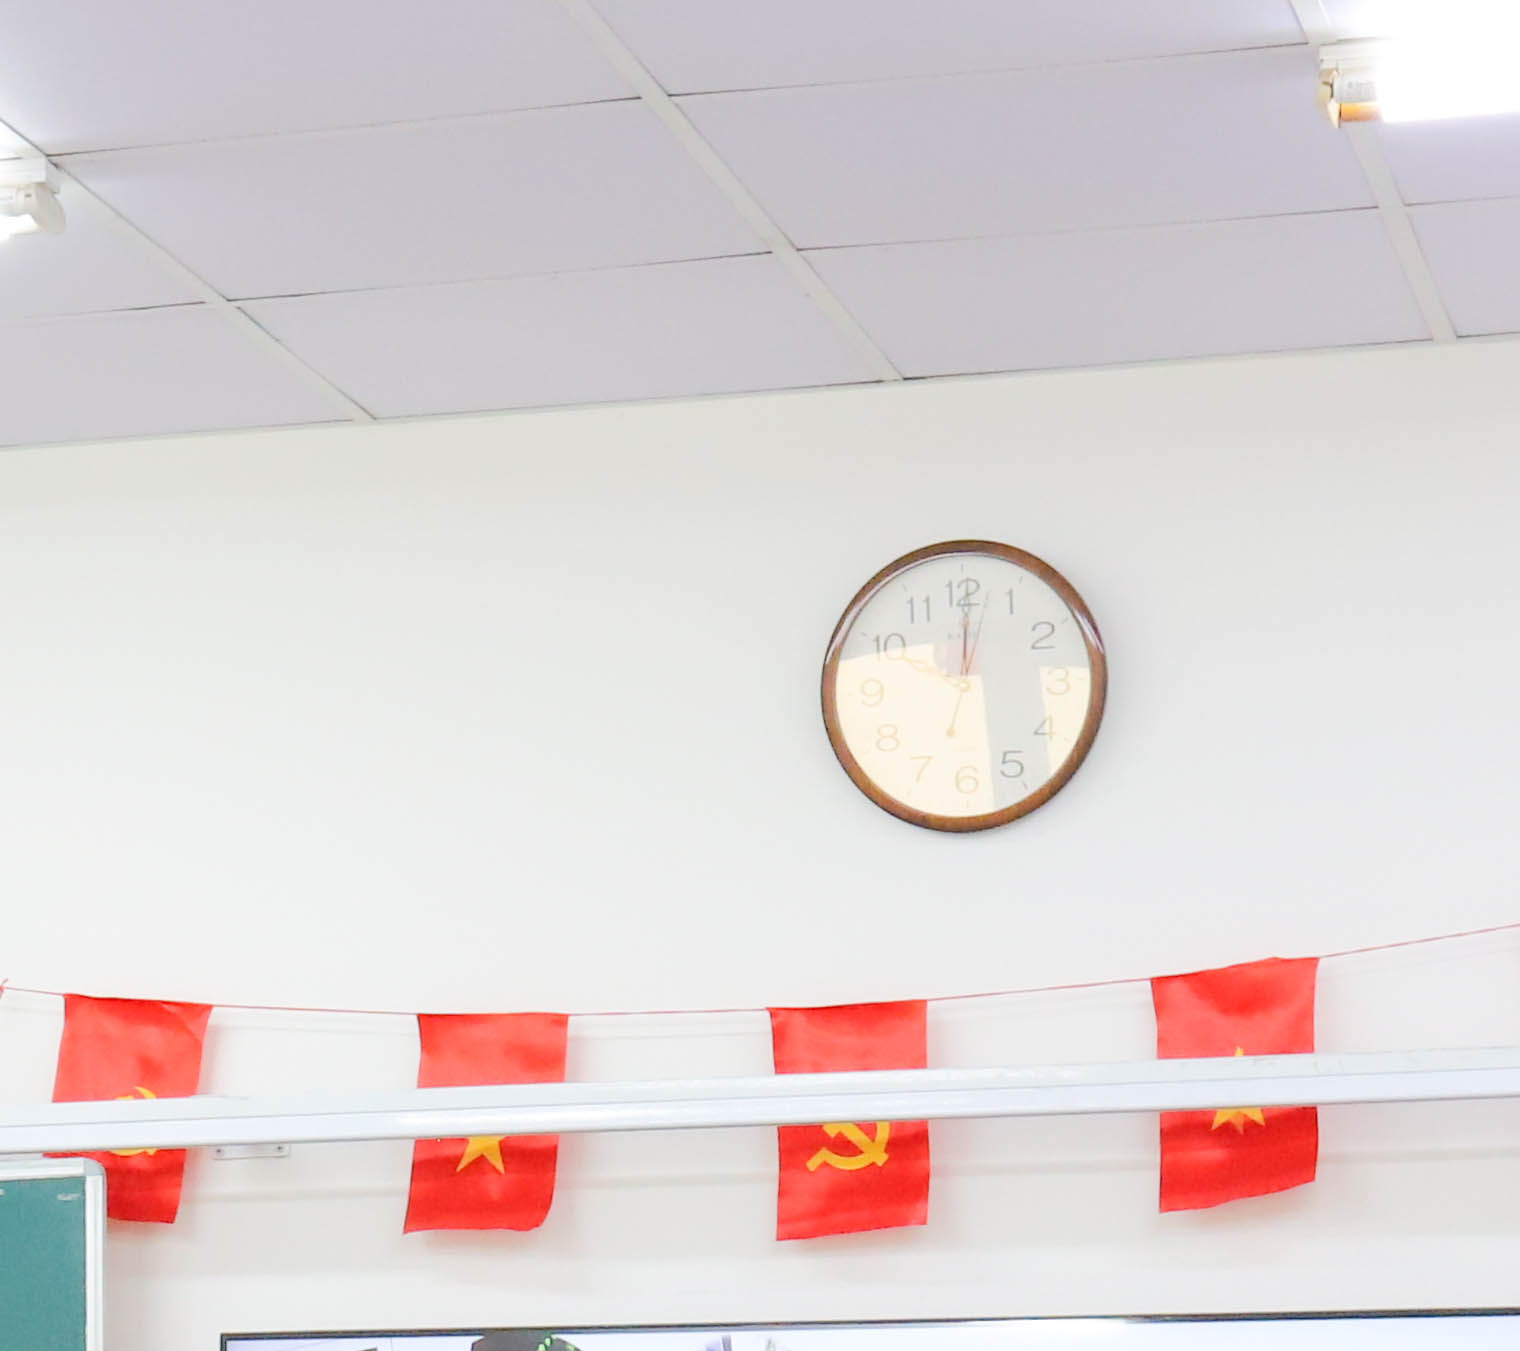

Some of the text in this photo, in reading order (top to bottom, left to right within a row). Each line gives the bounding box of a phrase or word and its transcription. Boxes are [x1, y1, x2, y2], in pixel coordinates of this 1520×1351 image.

[944, 577, 982, 609] 12
[906, 594, 932, 625] 11
[872, 632, 907, 662] 10
[1030, 621, 1056, 651] 2
[860, 677, 885, 707] 9
[1046, 667, 1071, 696] 3
[875, 723, 901, 753] 8
[1033, 714, 1056, 741] 4
[910, 755, 932, 783] 7
[1000, 750, 1025, 779] 5
[954, 766, 979, 794] 6
